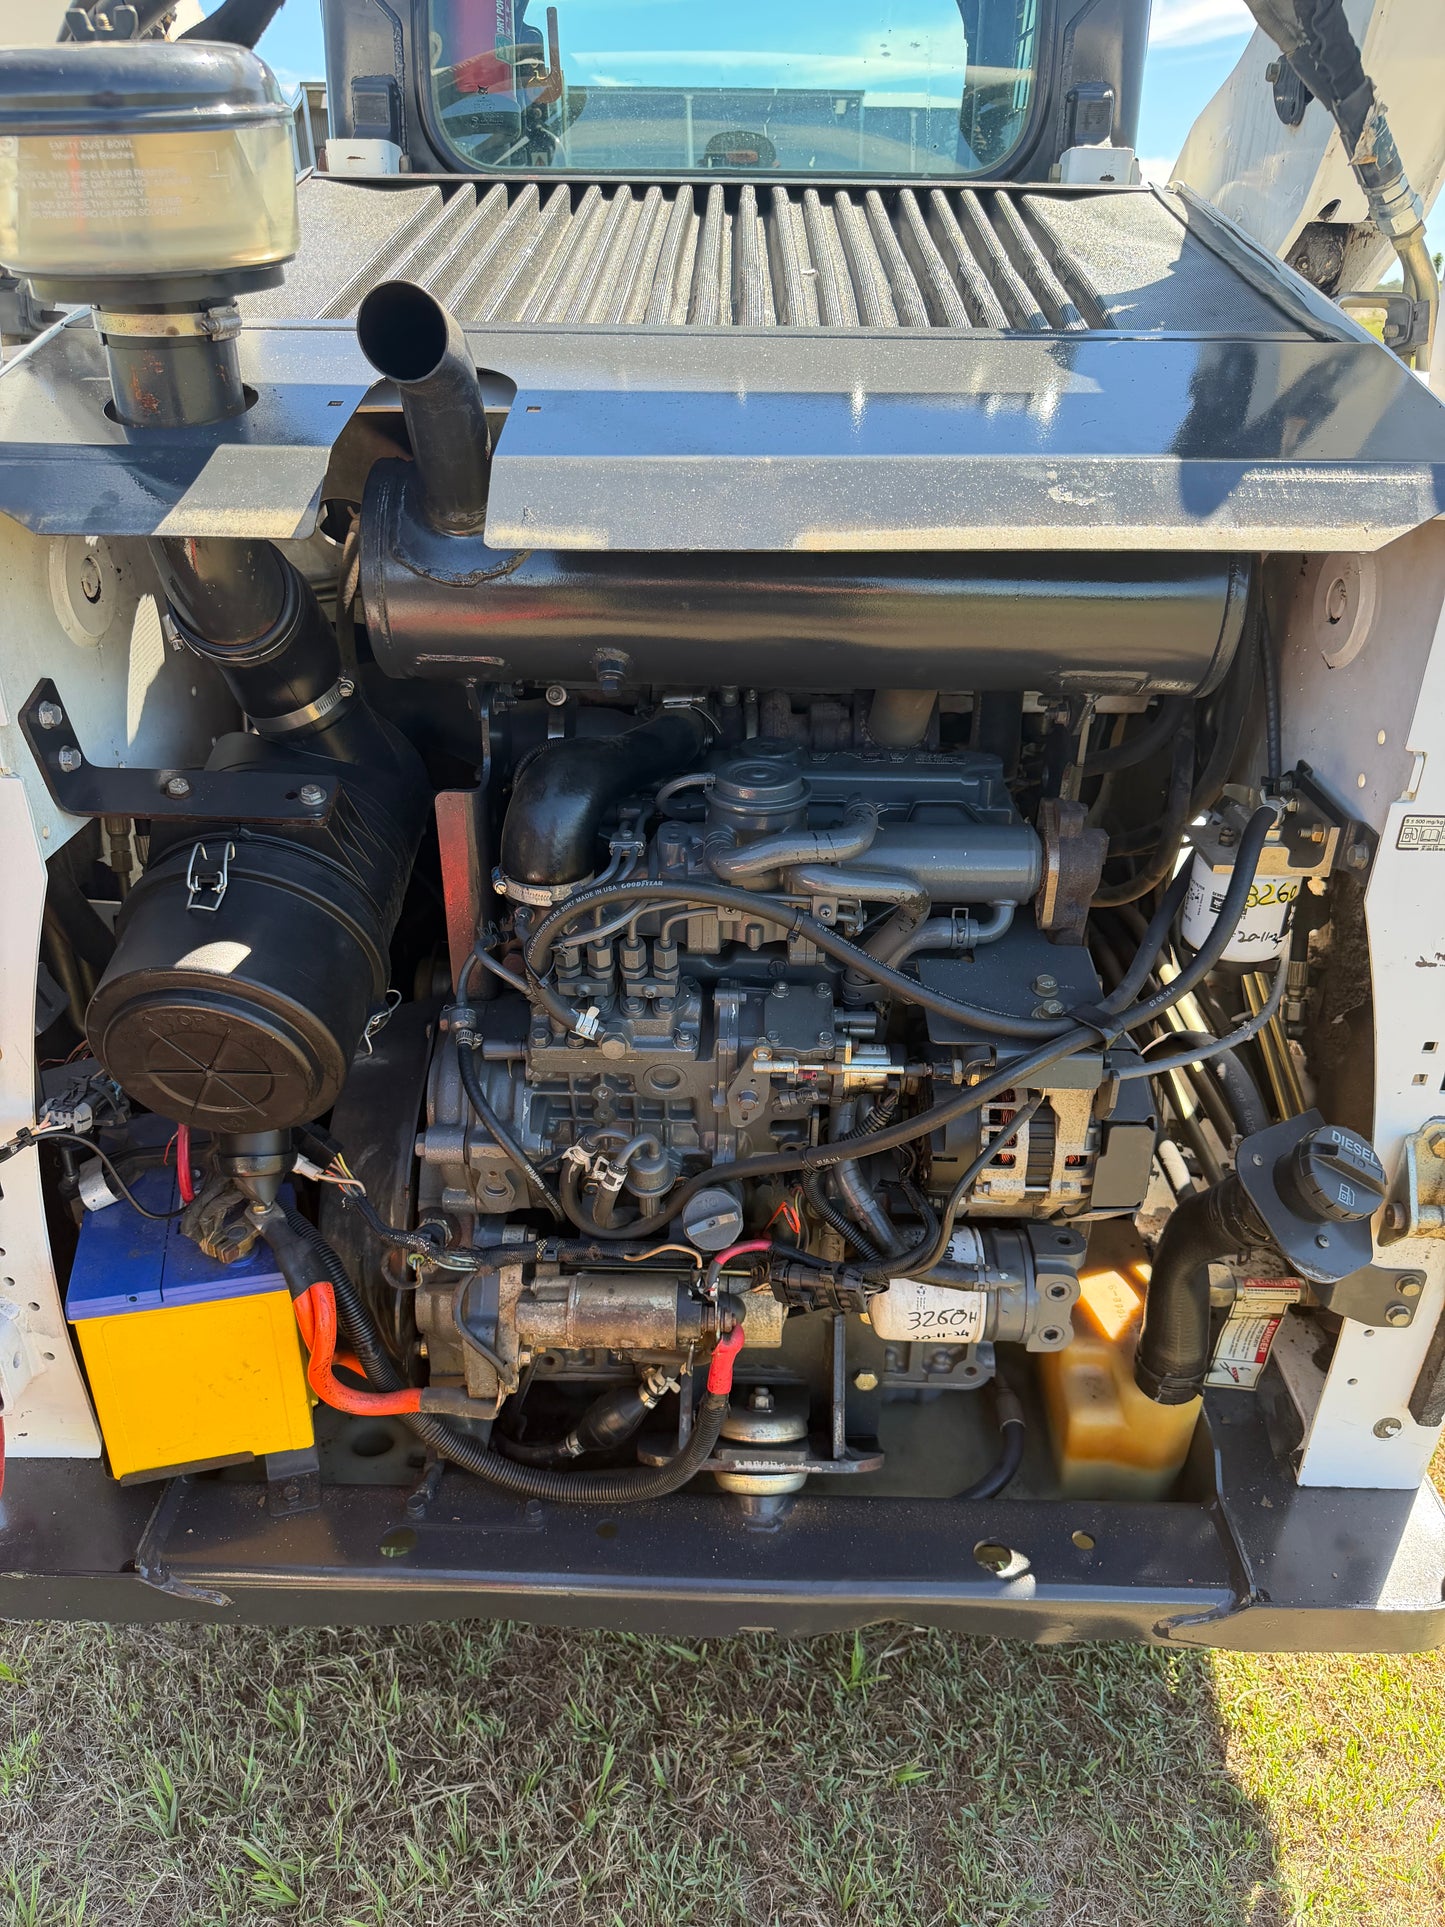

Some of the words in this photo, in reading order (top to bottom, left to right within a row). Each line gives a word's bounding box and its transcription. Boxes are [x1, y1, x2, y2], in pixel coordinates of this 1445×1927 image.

[496, 16, 505, 34] DRY
[80, 140, 105, 150] DUST
[107, 139, 133, 149] BOWL
[620, 880, 664, 890] GOODYEAR
[549, 911, 560, 922] SAE
[575, 890, 595, 903] MADE
[603, 885, 618, 894] USA
[160, 1013, 207, 1027] TOP
[1332, 1130, 1378, 1166] DIESEL
[1257, 1278, 1298, 1287] DANGER
[1258, 1325, 1274, 1353] DANGER
